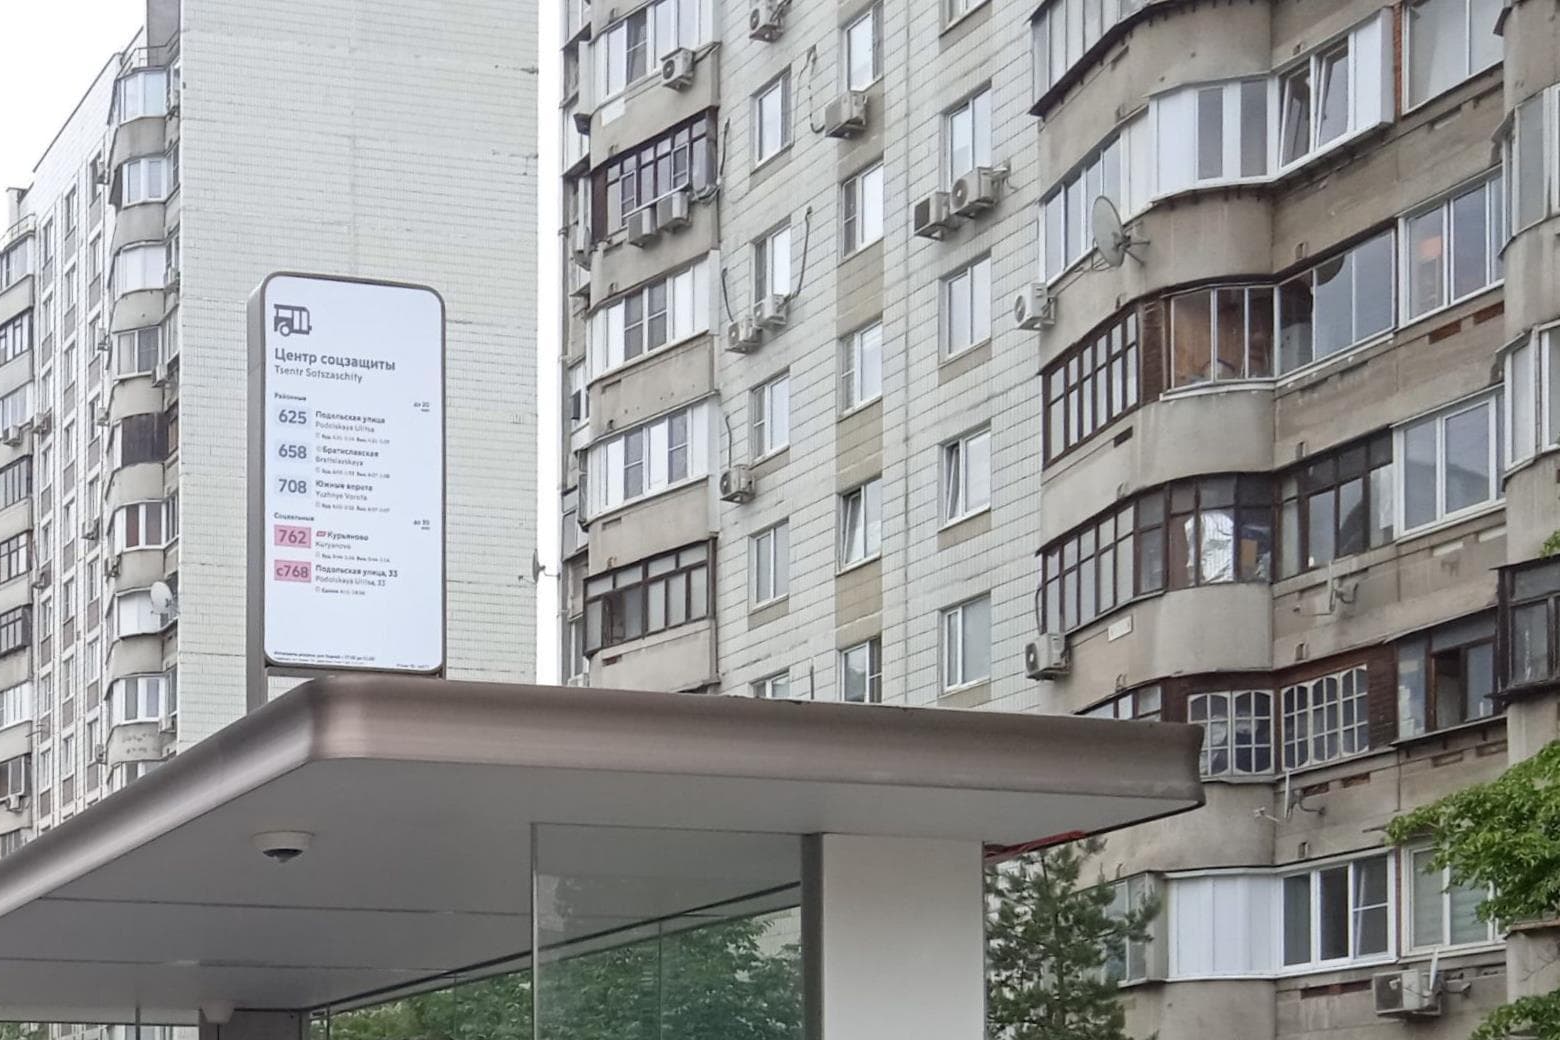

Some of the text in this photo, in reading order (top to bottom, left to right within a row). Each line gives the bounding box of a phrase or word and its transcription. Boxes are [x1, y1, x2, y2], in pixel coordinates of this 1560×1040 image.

[274, 347, 396, 371] Центр соцзащиты
[274, 365, 363, 384] Tsentr Sotszaschity
[278, 409, 307, 425] 625
[278, 444, 308, 460] 658
[278, 478, 308, 494] 708
[278, 529, 307, 545] 762
[276, 564, 309, 579] с768
